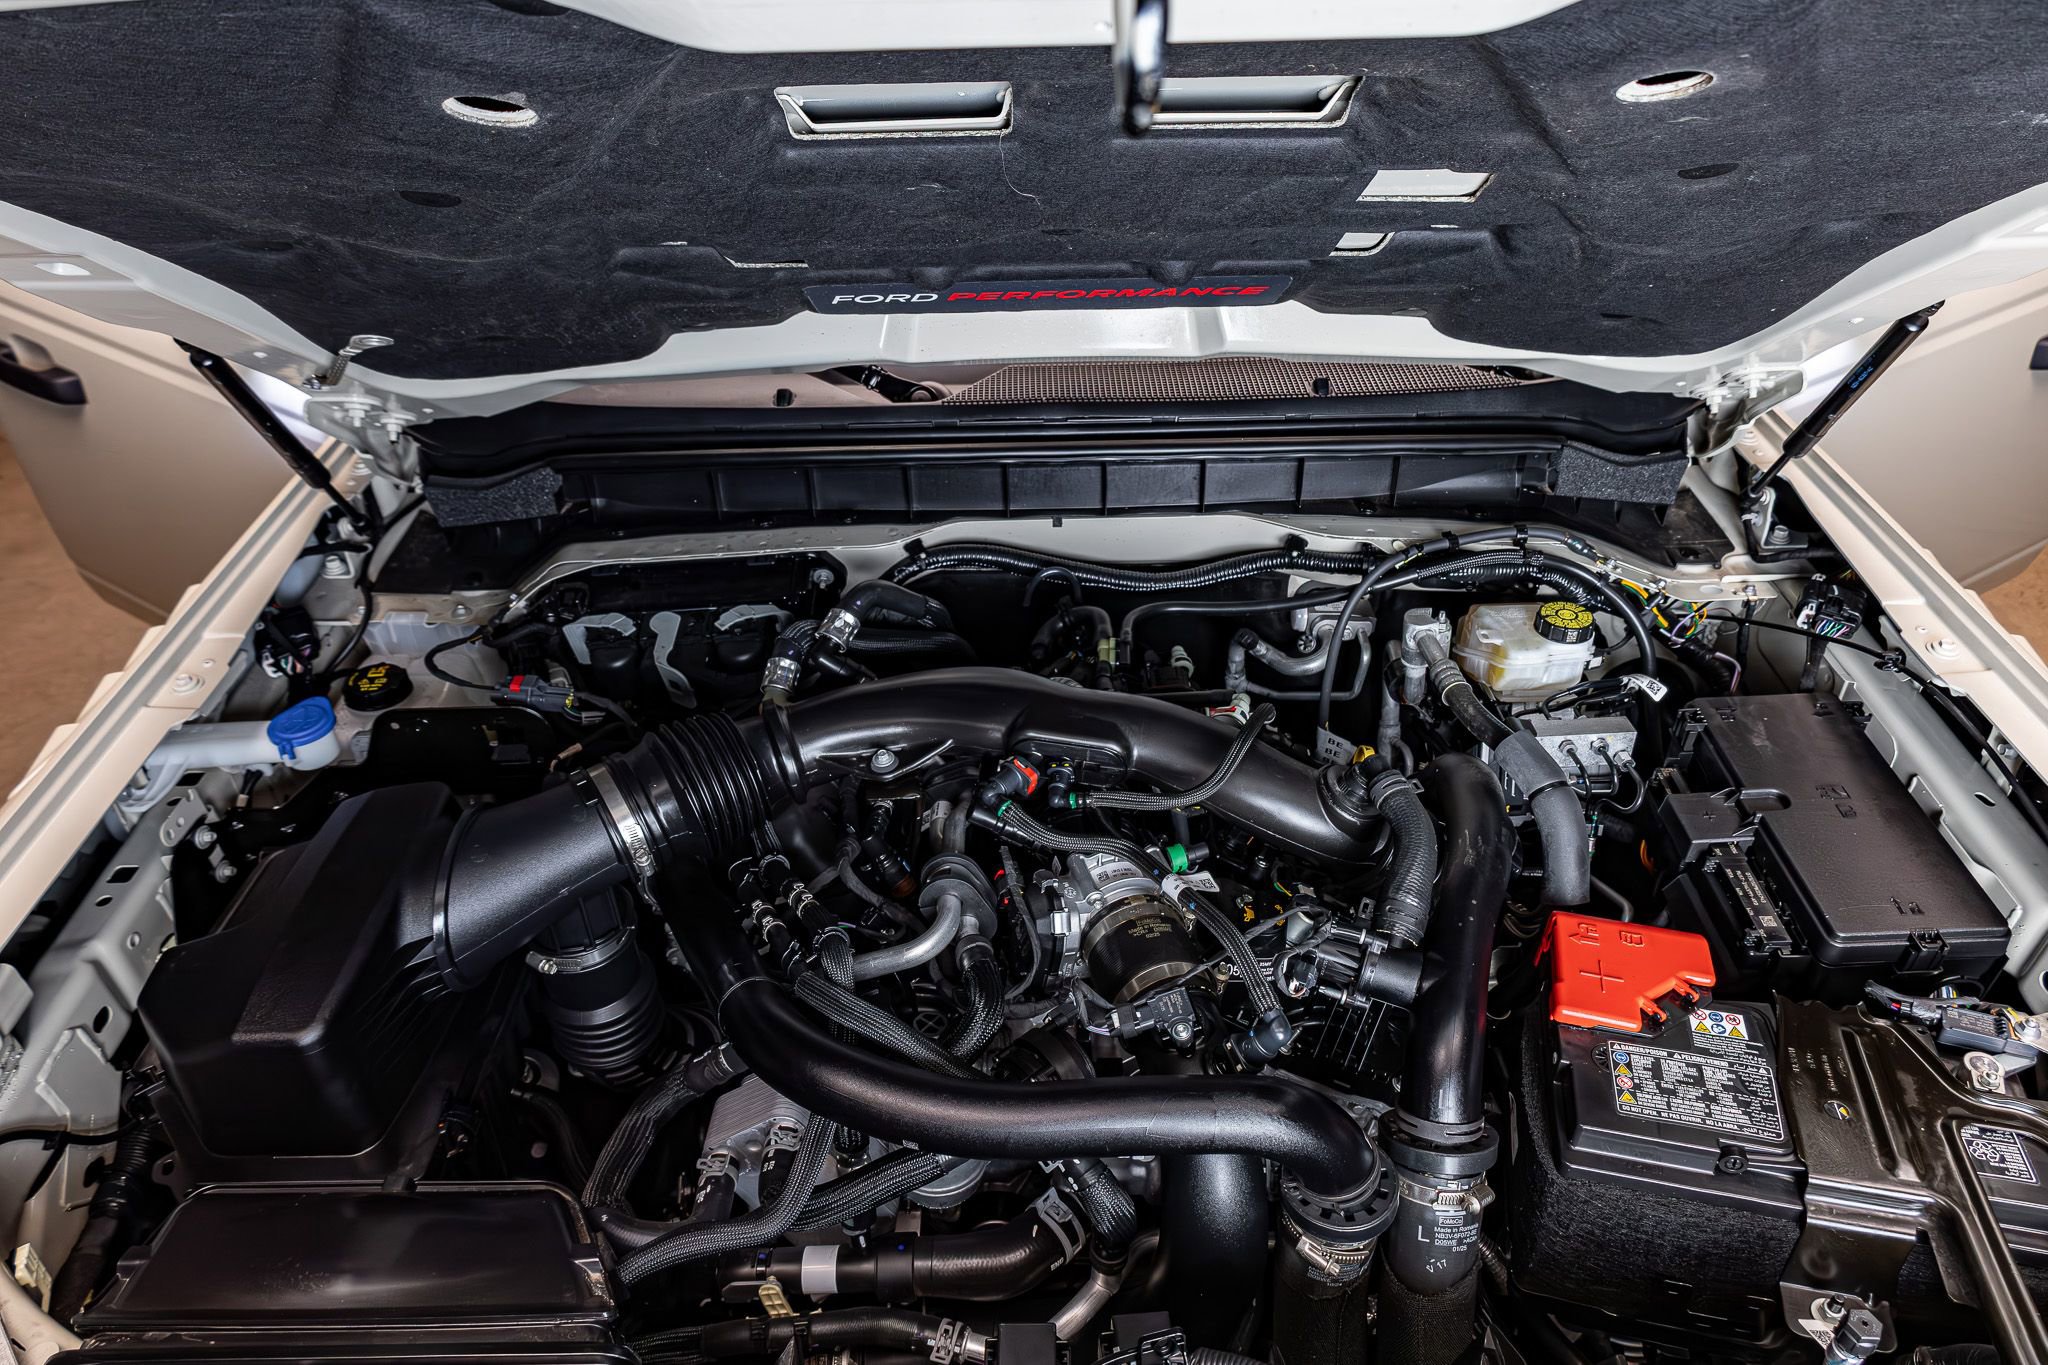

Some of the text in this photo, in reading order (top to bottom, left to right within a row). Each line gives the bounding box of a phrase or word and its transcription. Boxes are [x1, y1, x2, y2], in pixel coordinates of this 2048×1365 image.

[831, 286, 1271, 305] FORD PERFORMANCE
[1327, 737, 1344, 750] BE
[1418, 1225, 1430, 1243] L
